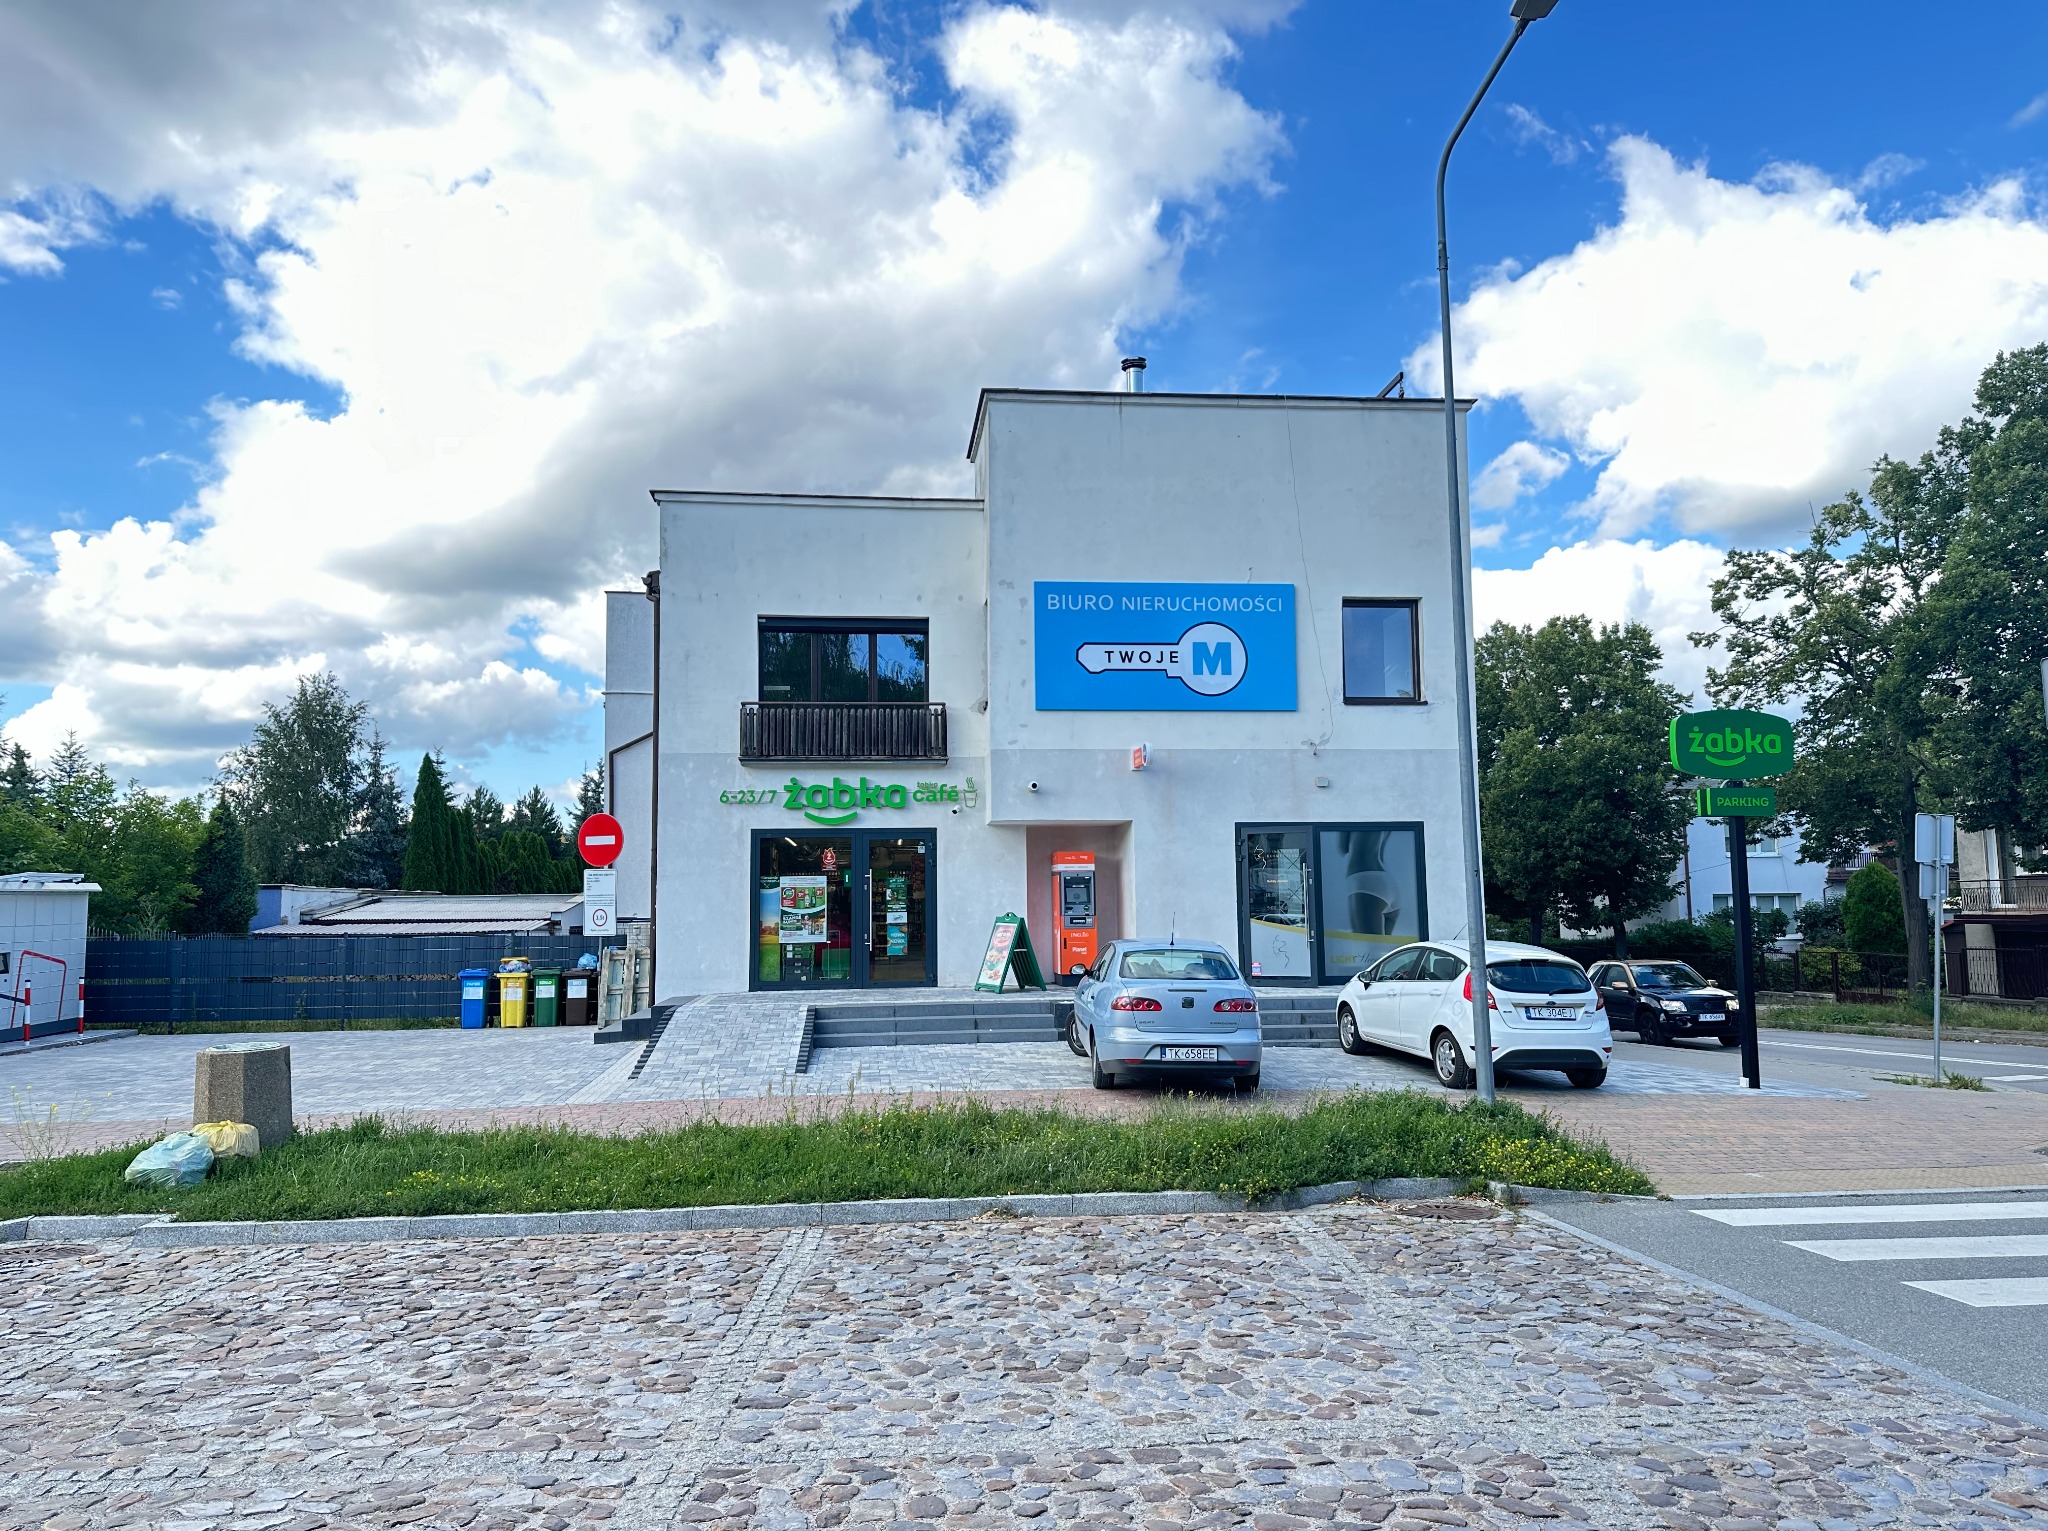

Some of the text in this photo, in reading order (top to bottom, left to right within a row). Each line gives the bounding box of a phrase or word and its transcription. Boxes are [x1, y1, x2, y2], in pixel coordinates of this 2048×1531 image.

[1047, 594, 1282, 612] BIURO NIERUCHOMOŚCI
[1104, 641, 1232, 676] TWOJE M
[1688, 726, 1782, 753] żabka
[783, 777, 908, 809] żabka
[912, 783, 959, 802] café
[1717, 797, 1769, 807] PARKING
[1531, 1007, 1544, 1017] TK
[1168, 1048, 1215, 1060] TK 658EE
